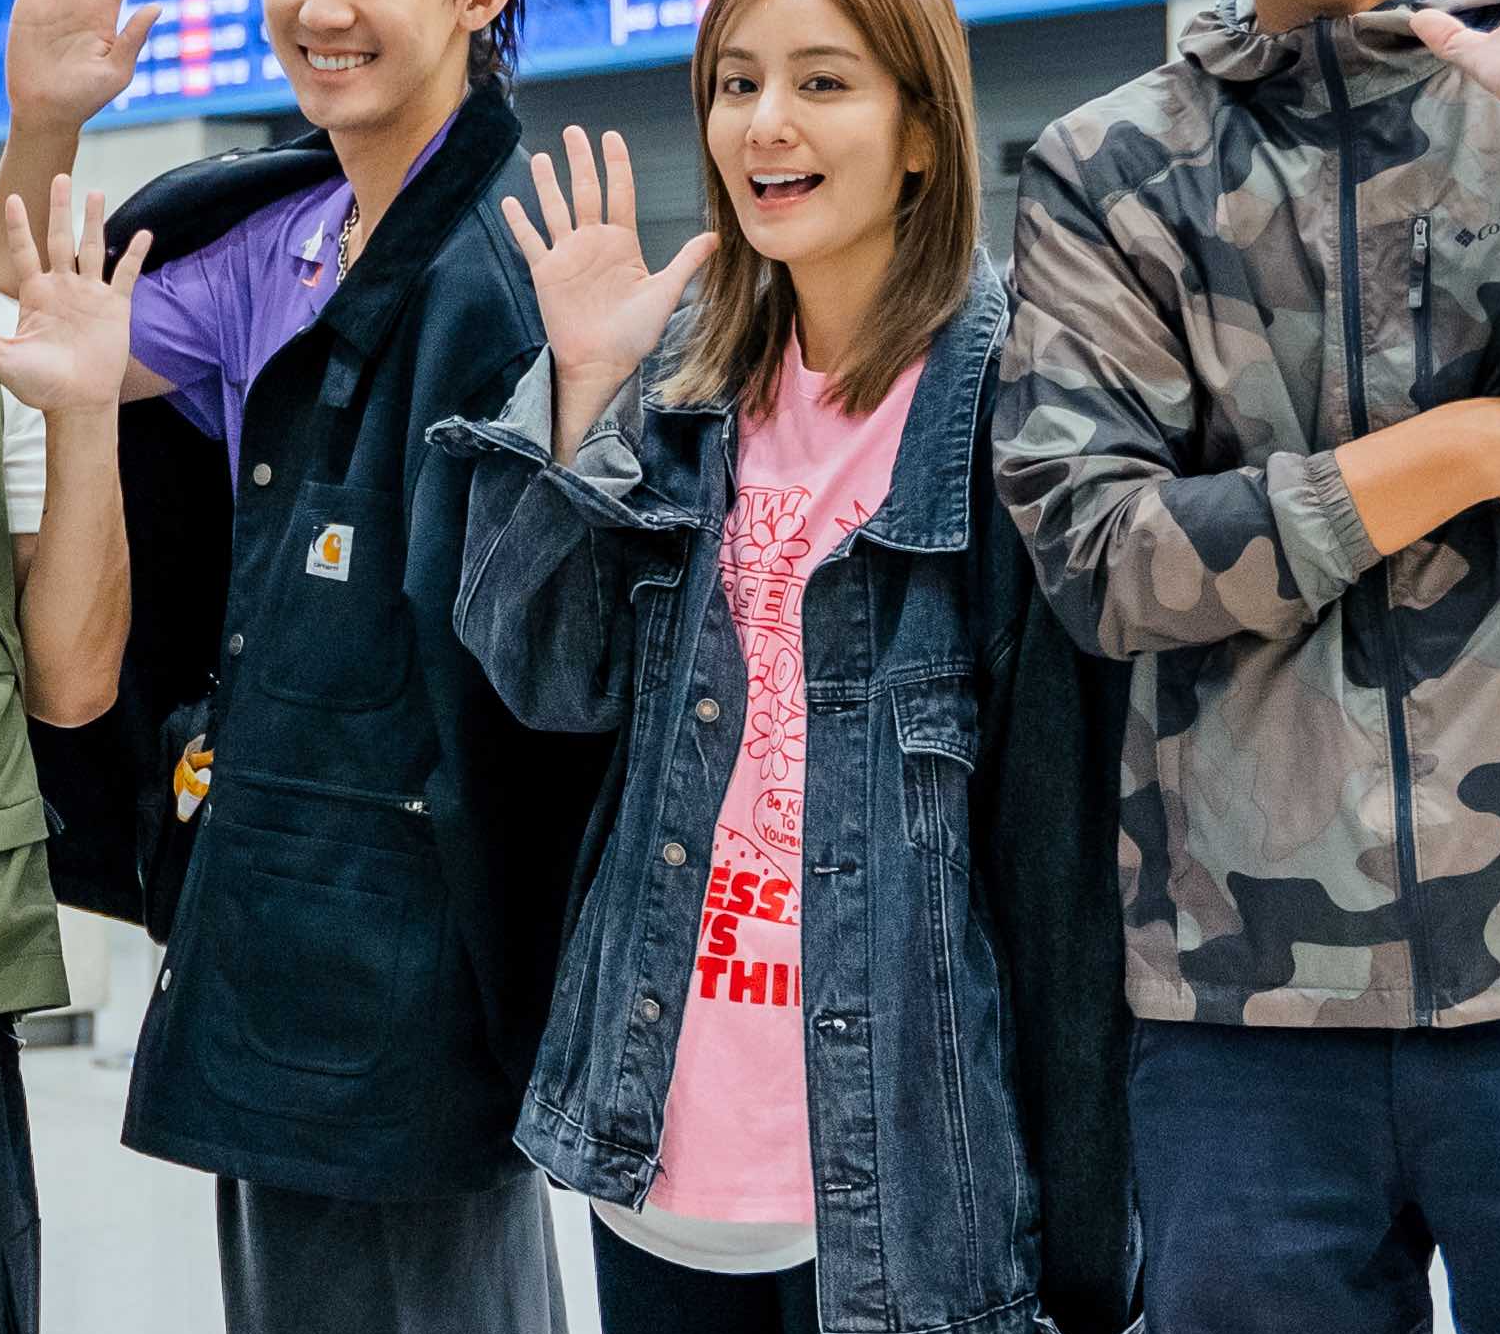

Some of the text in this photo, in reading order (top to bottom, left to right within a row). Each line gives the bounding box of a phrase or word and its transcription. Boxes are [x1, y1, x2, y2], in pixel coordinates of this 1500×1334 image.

[726, 491, 806, 540] OW
[780, 813, 795, 830] To
[786, 798, 803, 816] Ki
[696, 956, 800, 1007] THI
